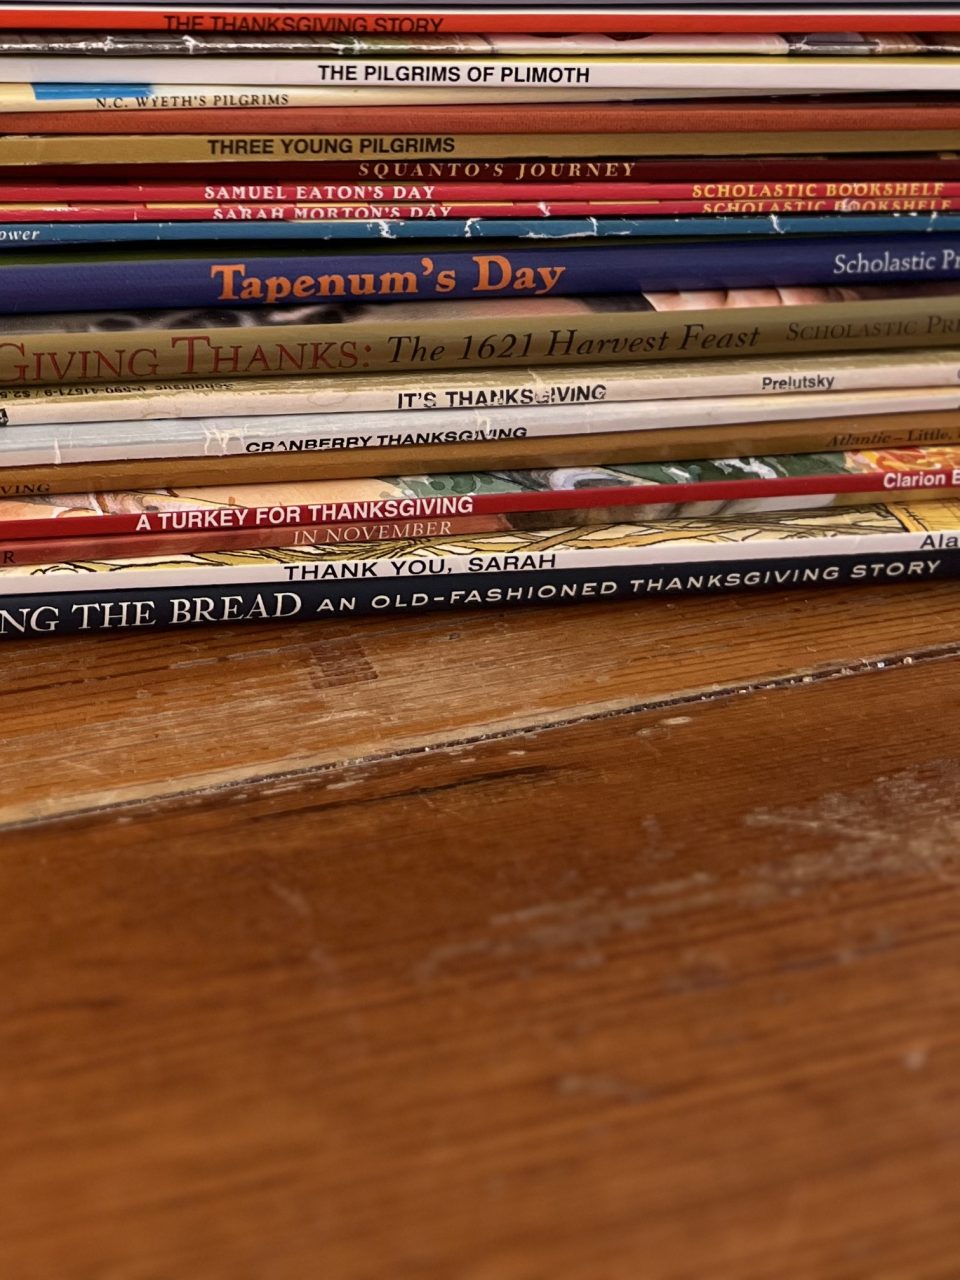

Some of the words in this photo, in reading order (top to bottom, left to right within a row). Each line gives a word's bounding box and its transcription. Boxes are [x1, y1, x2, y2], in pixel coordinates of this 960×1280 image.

[163, 15, 204, 31] THE
[210, 16, 368, 32] THANKSGIVING
[373, 17, 444, 33] STORY
[318, 65, 357, 81] THE
[363, 65, 461, 82] PILGRIMS
[467, 66, 494, 83] OF
[500, 67, 590, 83] PLIMOTH
[96, 97, 128, 109] N.C.
[136, 96, 207, 108] WYETH'S
[213, 94, 289, 107] PILGRIMS
[208, 139, 274, 155] THREE
[280, 138, 353, 154] YOUNG
[359, 137, 455, 154] PILGRIMS
[358, 162, 504, 179] SQUANTO'S
[515, 162, 637, 180] JOURNEY
[204, 185, 287, 200] SAMUEL
[296, 185, 384, 200] EATON'S
[393, 185, 435, 200] DAY
[691, 183, 819, 198] SCHOLASTIC
[826, 182, 945, 197] BOOKSHELF
[213, 206, 285, 220] SARAH
[294, 206, 401, 220] MORTON'S
[410, 206, 452, 219] DAY
[210, 257, 456, 304] Tapenum's
[472, 255, 566, 294] Day
[833, 251, 936, 274] Scholastic
[170, 335, 371, 375] THANKS:
[386, 335, 446, 364] The
[456, 332, 533, 361] 1621
[544, 328, 669, 357] Harvest
[676, 324, 761, 351] Feast
[786, 321, 919, 342] SCHOLASTIC
[397, 392, 437, 409] IT'S
[762, 374, 835, 390] Prelutsky
[135, 513, 151, 531] A
[157, 508, 249, 530] TURKEY
[255, 505, 300, 526] FOR
[309, 496, 474, 522] THANKSGIVING
[883, 471, 946, 488] Clarion
[292, 529, 319, 545] IN
[325, 520, 452, 543] NOVEMBER
[283, 562, 378, 581] THANK
[390, 558, 453, 577] YOU,
[467, 553, 557, 573] SARAH
[71, 600, 156, 629] THE
[168, 591, 302, 625] BREAD
[316, 597, 356, 612] AN
[370, 581, 619, 609] OLD-FASHIONED
[629, 566, 840, 592] THANKSGIVING
[850, 560, 942, 578] STORY
